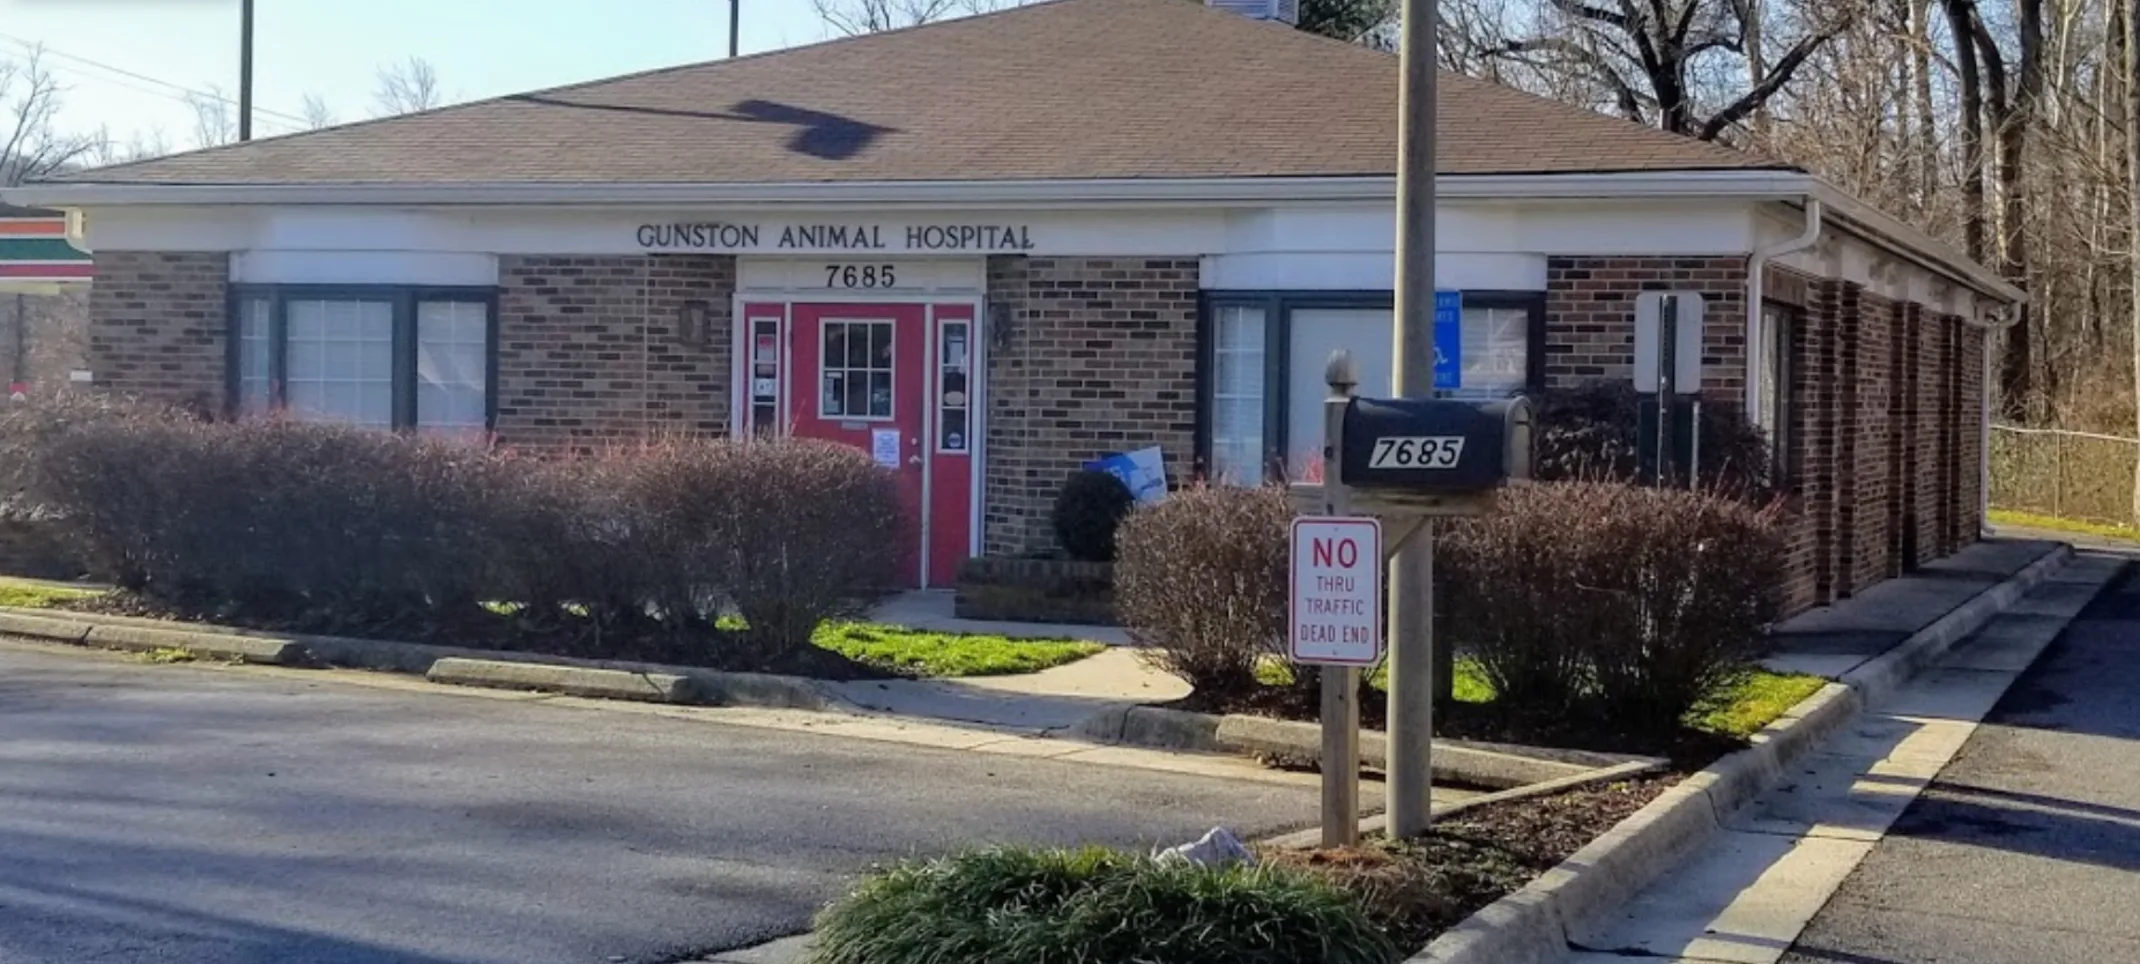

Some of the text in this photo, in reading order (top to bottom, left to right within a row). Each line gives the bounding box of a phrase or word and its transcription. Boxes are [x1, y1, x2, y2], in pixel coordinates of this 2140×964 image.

[637, 224, 1035, 249] GUNSTON ANIMAL HOSPITAL
[825, 264, 895, 289] 7685
[1375, 439, 1459, 465] 7685
[1312, 537, 1357, 568] NO
[1316, 575, 1355, 592] THRU
[1304, 598, 1364, 616] TRAFFIC
[1300, 623, 1370, 644] DEAD END
